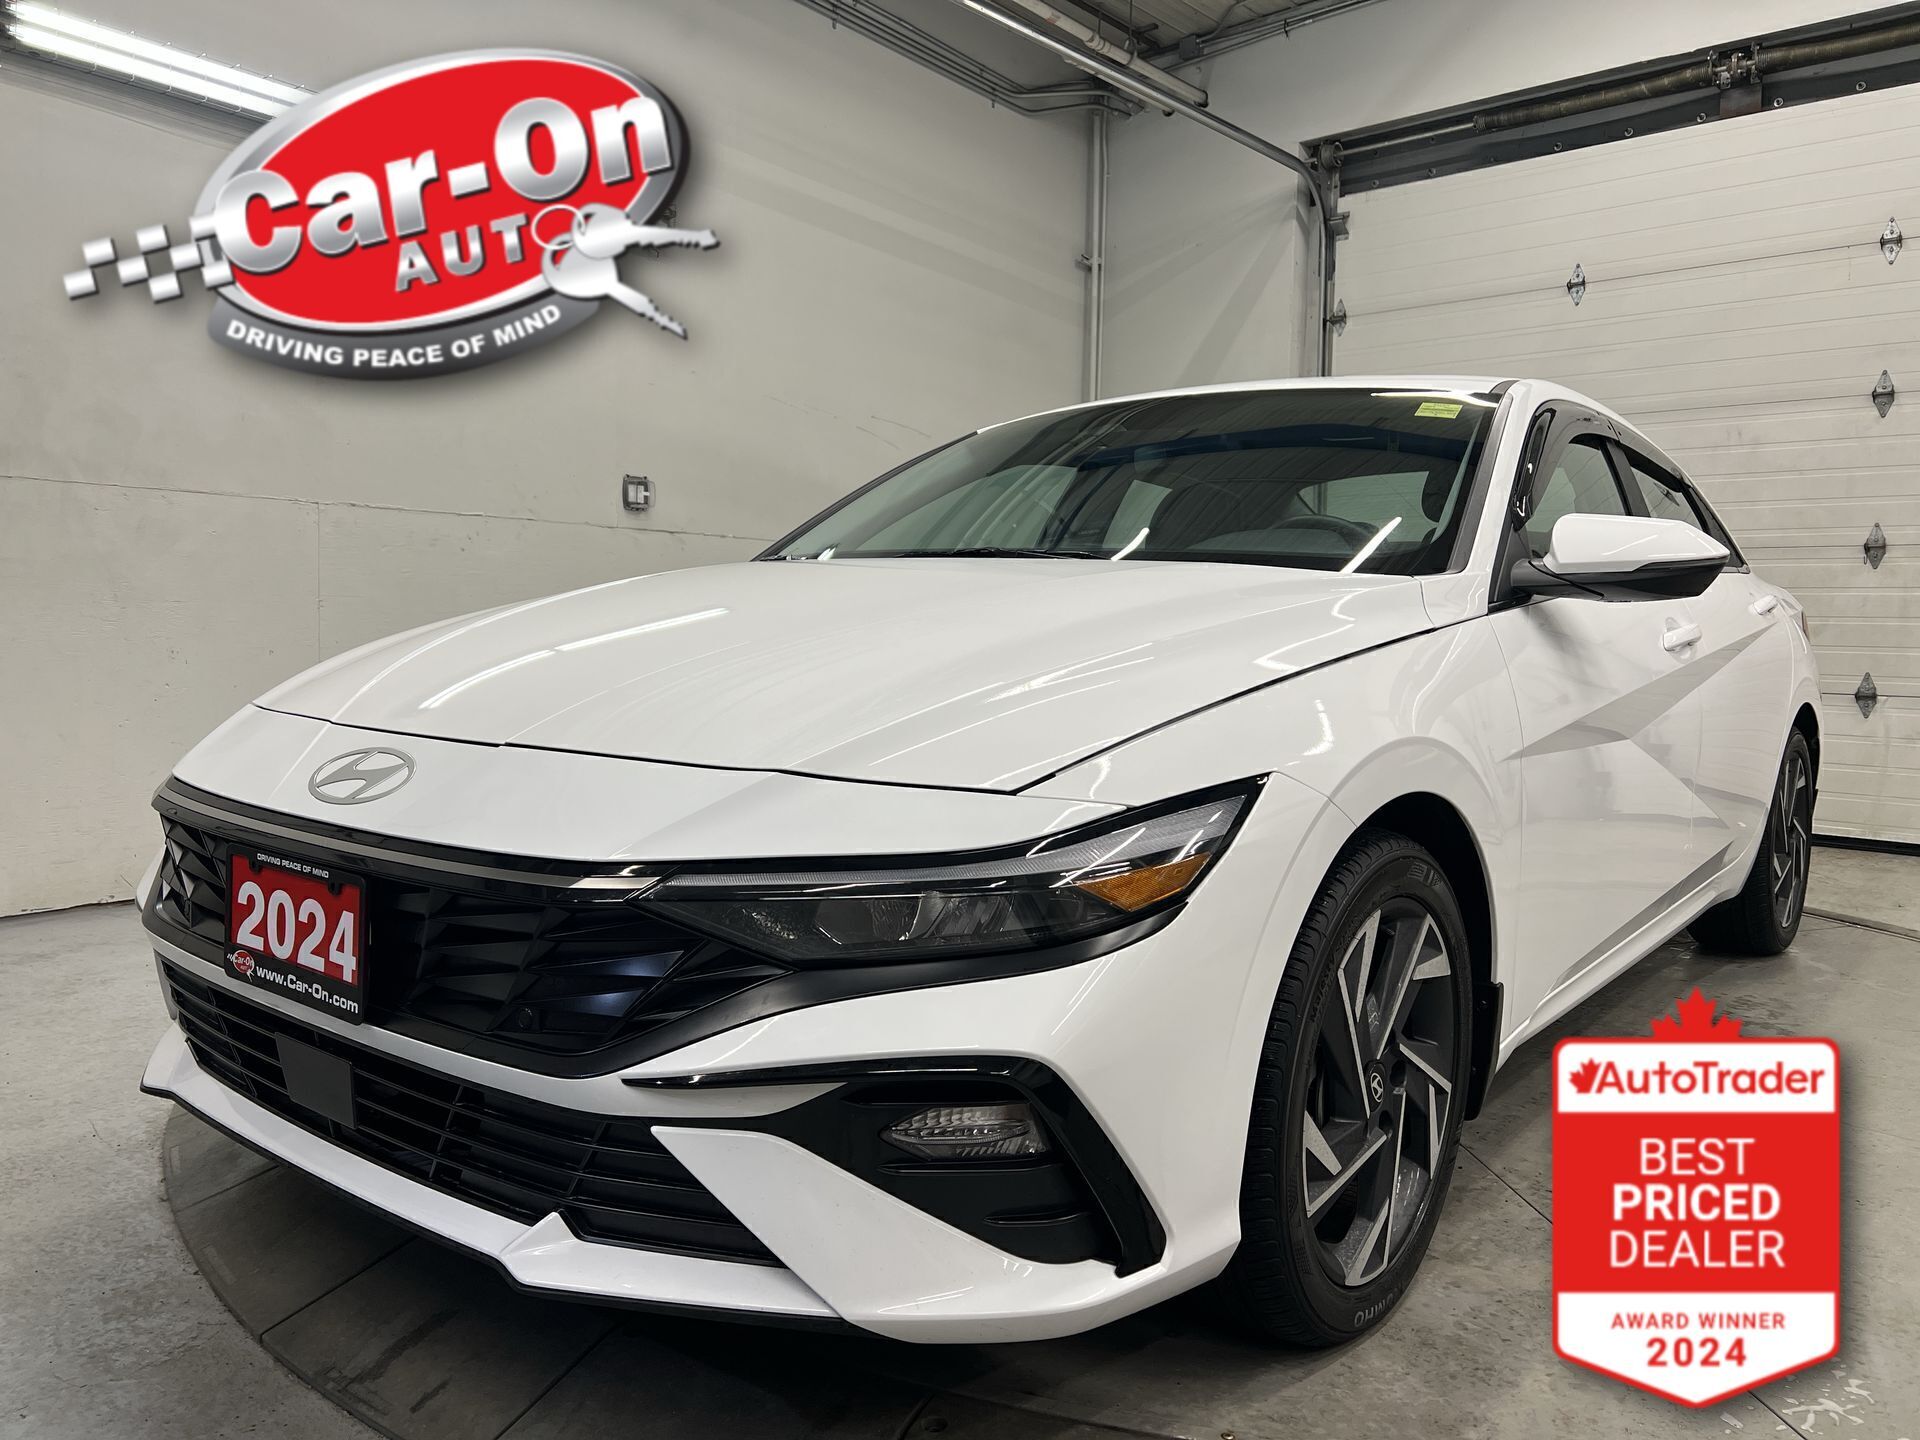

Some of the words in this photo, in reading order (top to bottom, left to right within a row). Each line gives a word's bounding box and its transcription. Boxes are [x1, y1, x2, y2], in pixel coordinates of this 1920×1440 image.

[257, 853, 281, 865] DRIVING
[281, 859, 301, 871] PEACE
[302, 865, 311, 873] OF
[312, 867, 329, 878] MIND
[236, 880, 357, 984] 2024
[256, 965, 359, 1014] www.Car-On.com
[1353, 1287, 1400, 1328] UMHO
